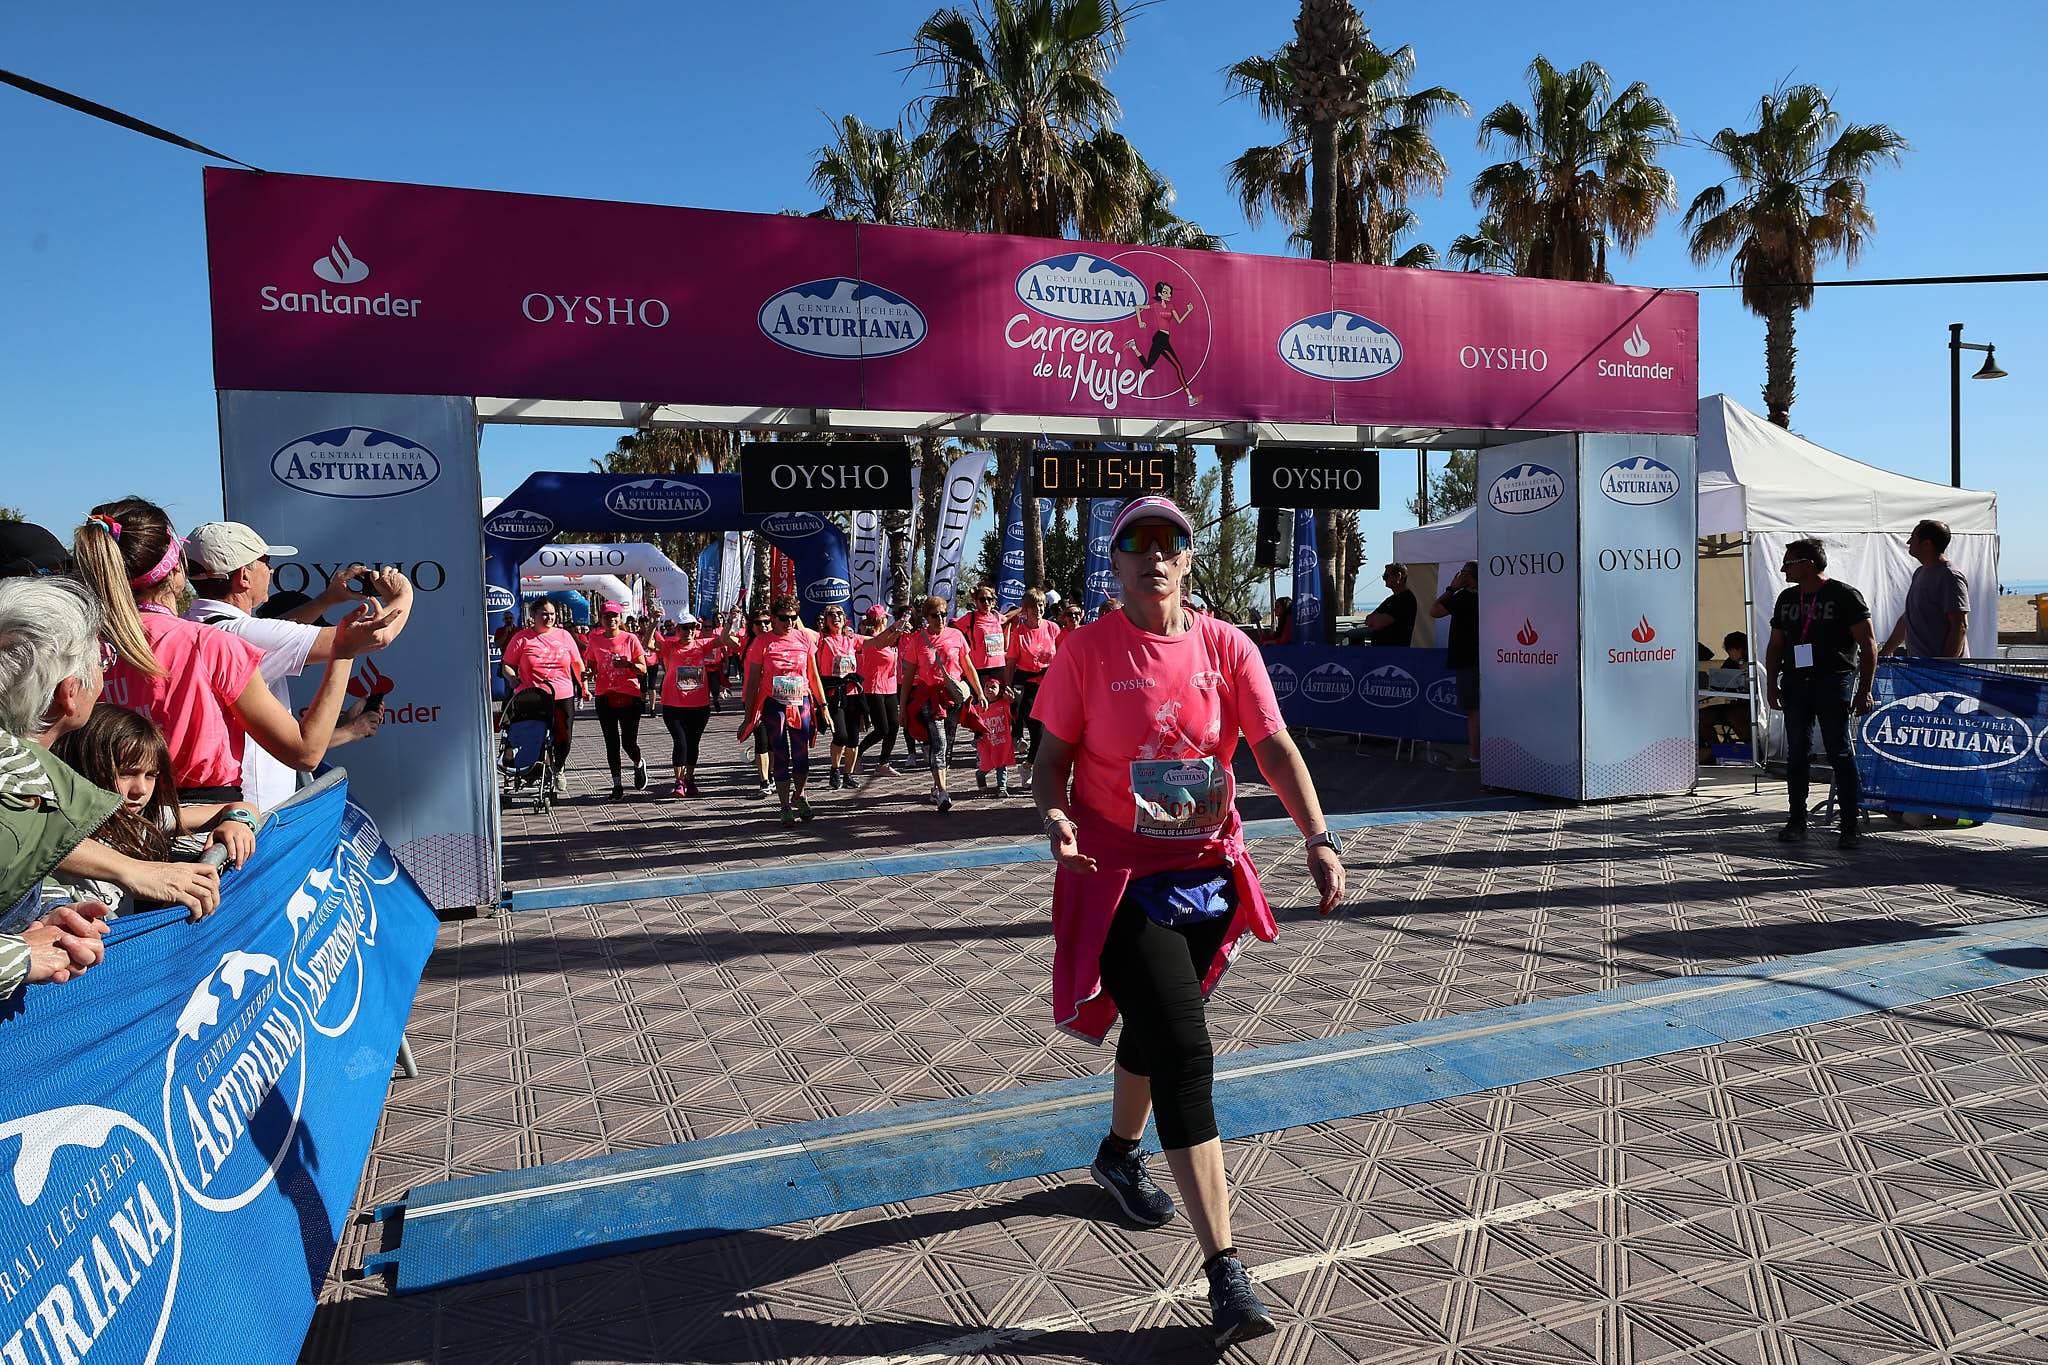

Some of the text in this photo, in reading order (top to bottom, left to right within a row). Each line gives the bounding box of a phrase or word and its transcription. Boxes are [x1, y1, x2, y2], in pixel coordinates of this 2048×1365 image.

[1026, 274, 1138, 308] ASTURIANA
[1046, 274, 1135, 289] CENTRAL LECHERA
[260, 286, 422, 318] Santander
[522, 293, 670, 328] OYSHO
[798, 303, 911, 317] CENTRAL LECHERA
[772, 303, 916, 341] ASTURIANA
[1004, 313, 1115, 356] Carrera
[1288, 333, 1394, 366] ASTURIANA
[1306, 332, 1390, 346] CENTRAL LECHERA
[1459, 345, 1549, 373] OYSHO
[1597, 359, 1675, 381] Santander
[1032, 351, 1155, 411] de la Mujer
[284, 452, 429, 481] ASTURIANA
[310, 451, 423, 460] CENTRAL LECHERA
[770, 464, 889, 490] OYSHO
[1272, 466, 1363, 491] OYSHO
[1606, 474, 1674, 494] ASTURIANA
[613, 491, 704, 511] ASTURIANA
[1493, 484, 1559, 505] ASTURIANA
[488, 520, 550, 534] ASTURIANA
[766, 520, 821, 532] ASTURIANA
[930, 476, 976, 603] OYSHO
[539, 549, 625, 568] OYSHO
[852, 510, 877, 617] OYSHO
[1489, 552, 1565, 577] OYSHO
[1598, 547, 1682, 572] OYSHO
[272, 560, 446, 597] OYSO
[1496, 648, 1559, 665] Santander
[1607, 646, 1677, 664] Santander
[1111, 677, 1156, 692] OYSHO
[1304, 677, 1351, 694] ASTURIANA
[1362, 680, 1413, 699] ASTURIANA
[1872, 715, 2018, 755] ASTURIANA
[1901, 714, 2015, 732] CENTRAL LECHERA
[1165, 773, 1206, 782] ASTURIANA
[1140, 827, 1167, 836] CARRERA
[195, 1026, 241, 1084] CENTRAL
[182, 1004, 302, 1190] ASTURIANA
[45, 1141, 137, 1251] LECHERA
